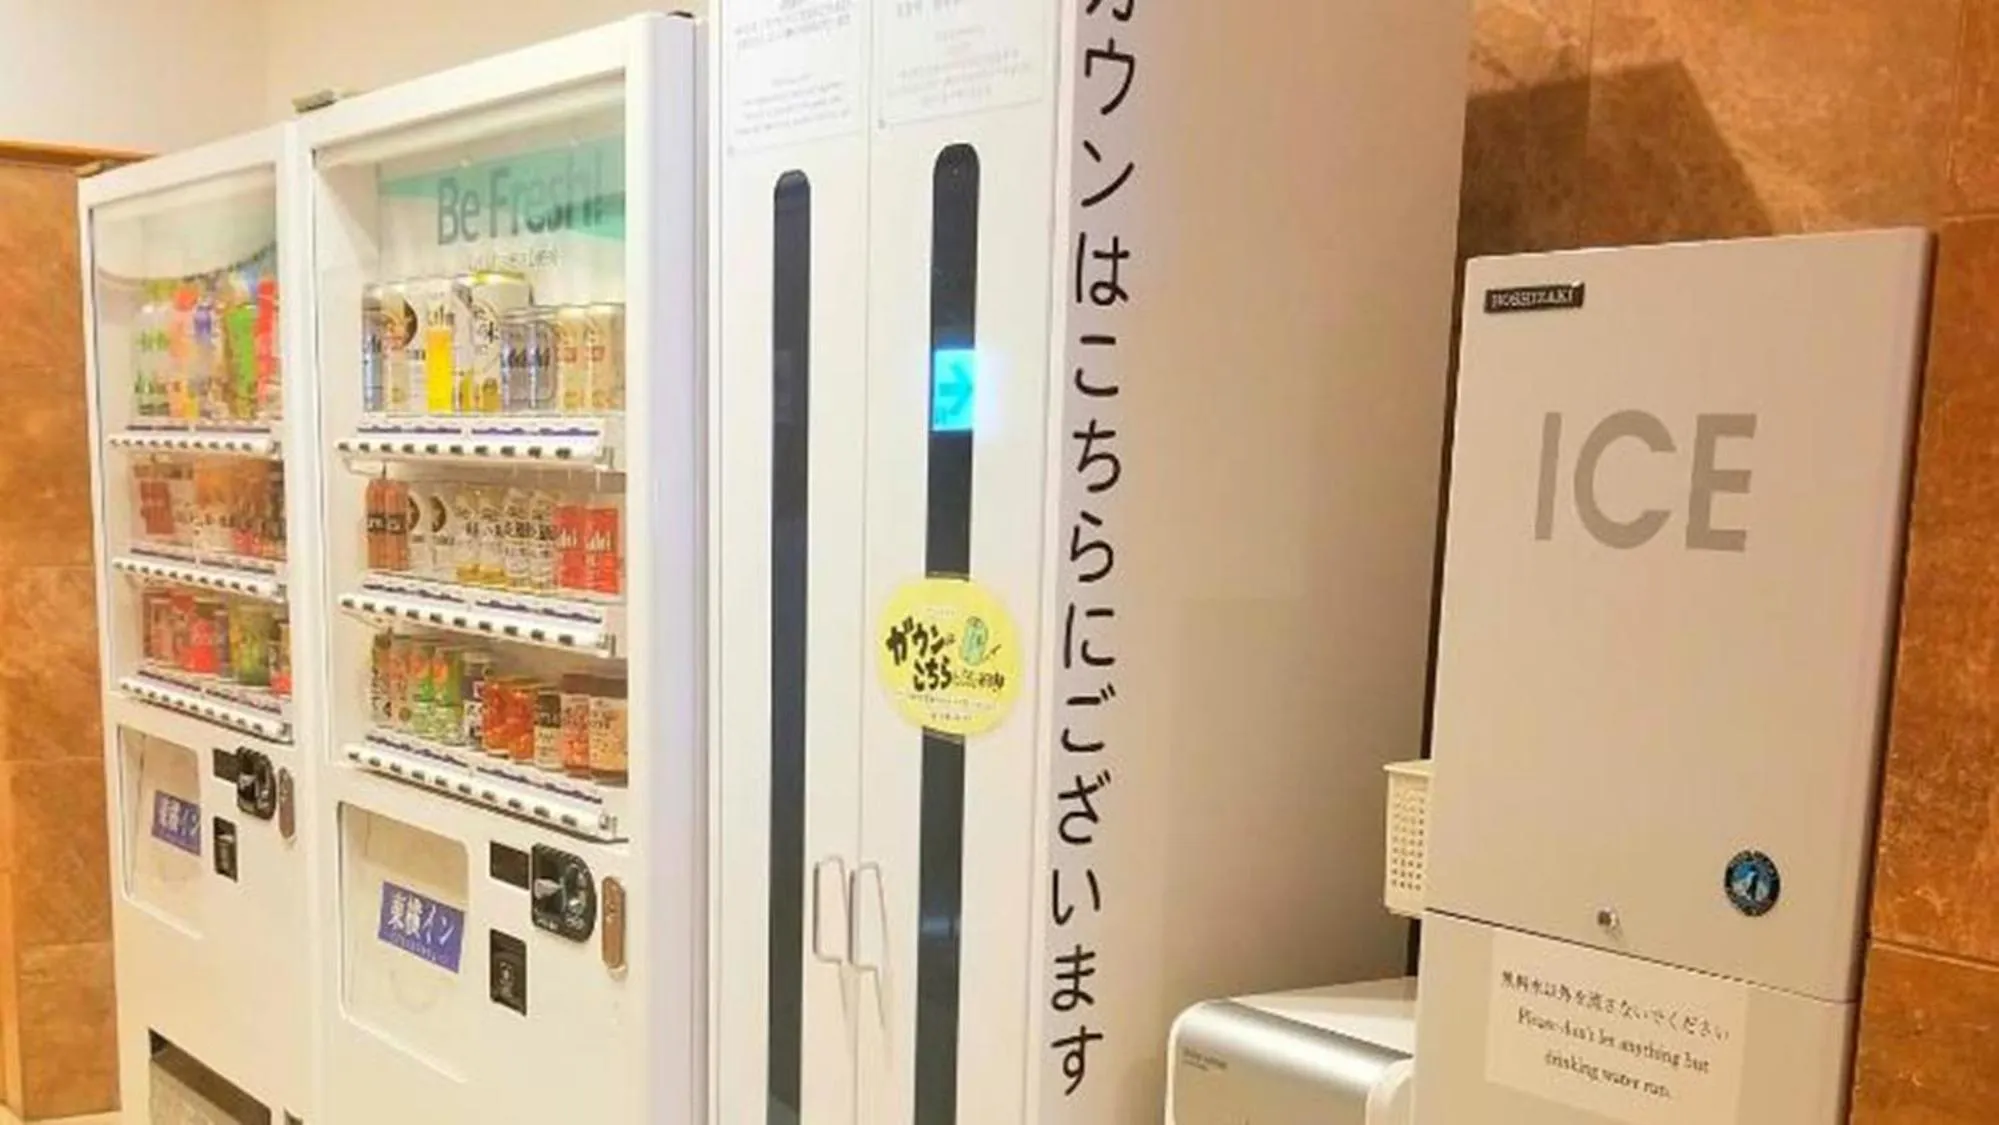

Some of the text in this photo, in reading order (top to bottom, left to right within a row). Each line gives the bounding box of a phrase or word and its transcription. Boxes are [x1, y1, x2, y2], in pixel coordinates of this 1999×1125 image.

[437, 175, 481, 246] Be
[1534, 409, 1757, 552] ICE
[387, 891, 456, 946] 東横イン
[1544, 1049, 1600, 1084] drinking
[1619, 1039, 1681, 1072] anything
[1683, 1051, 1710, 1074] but
